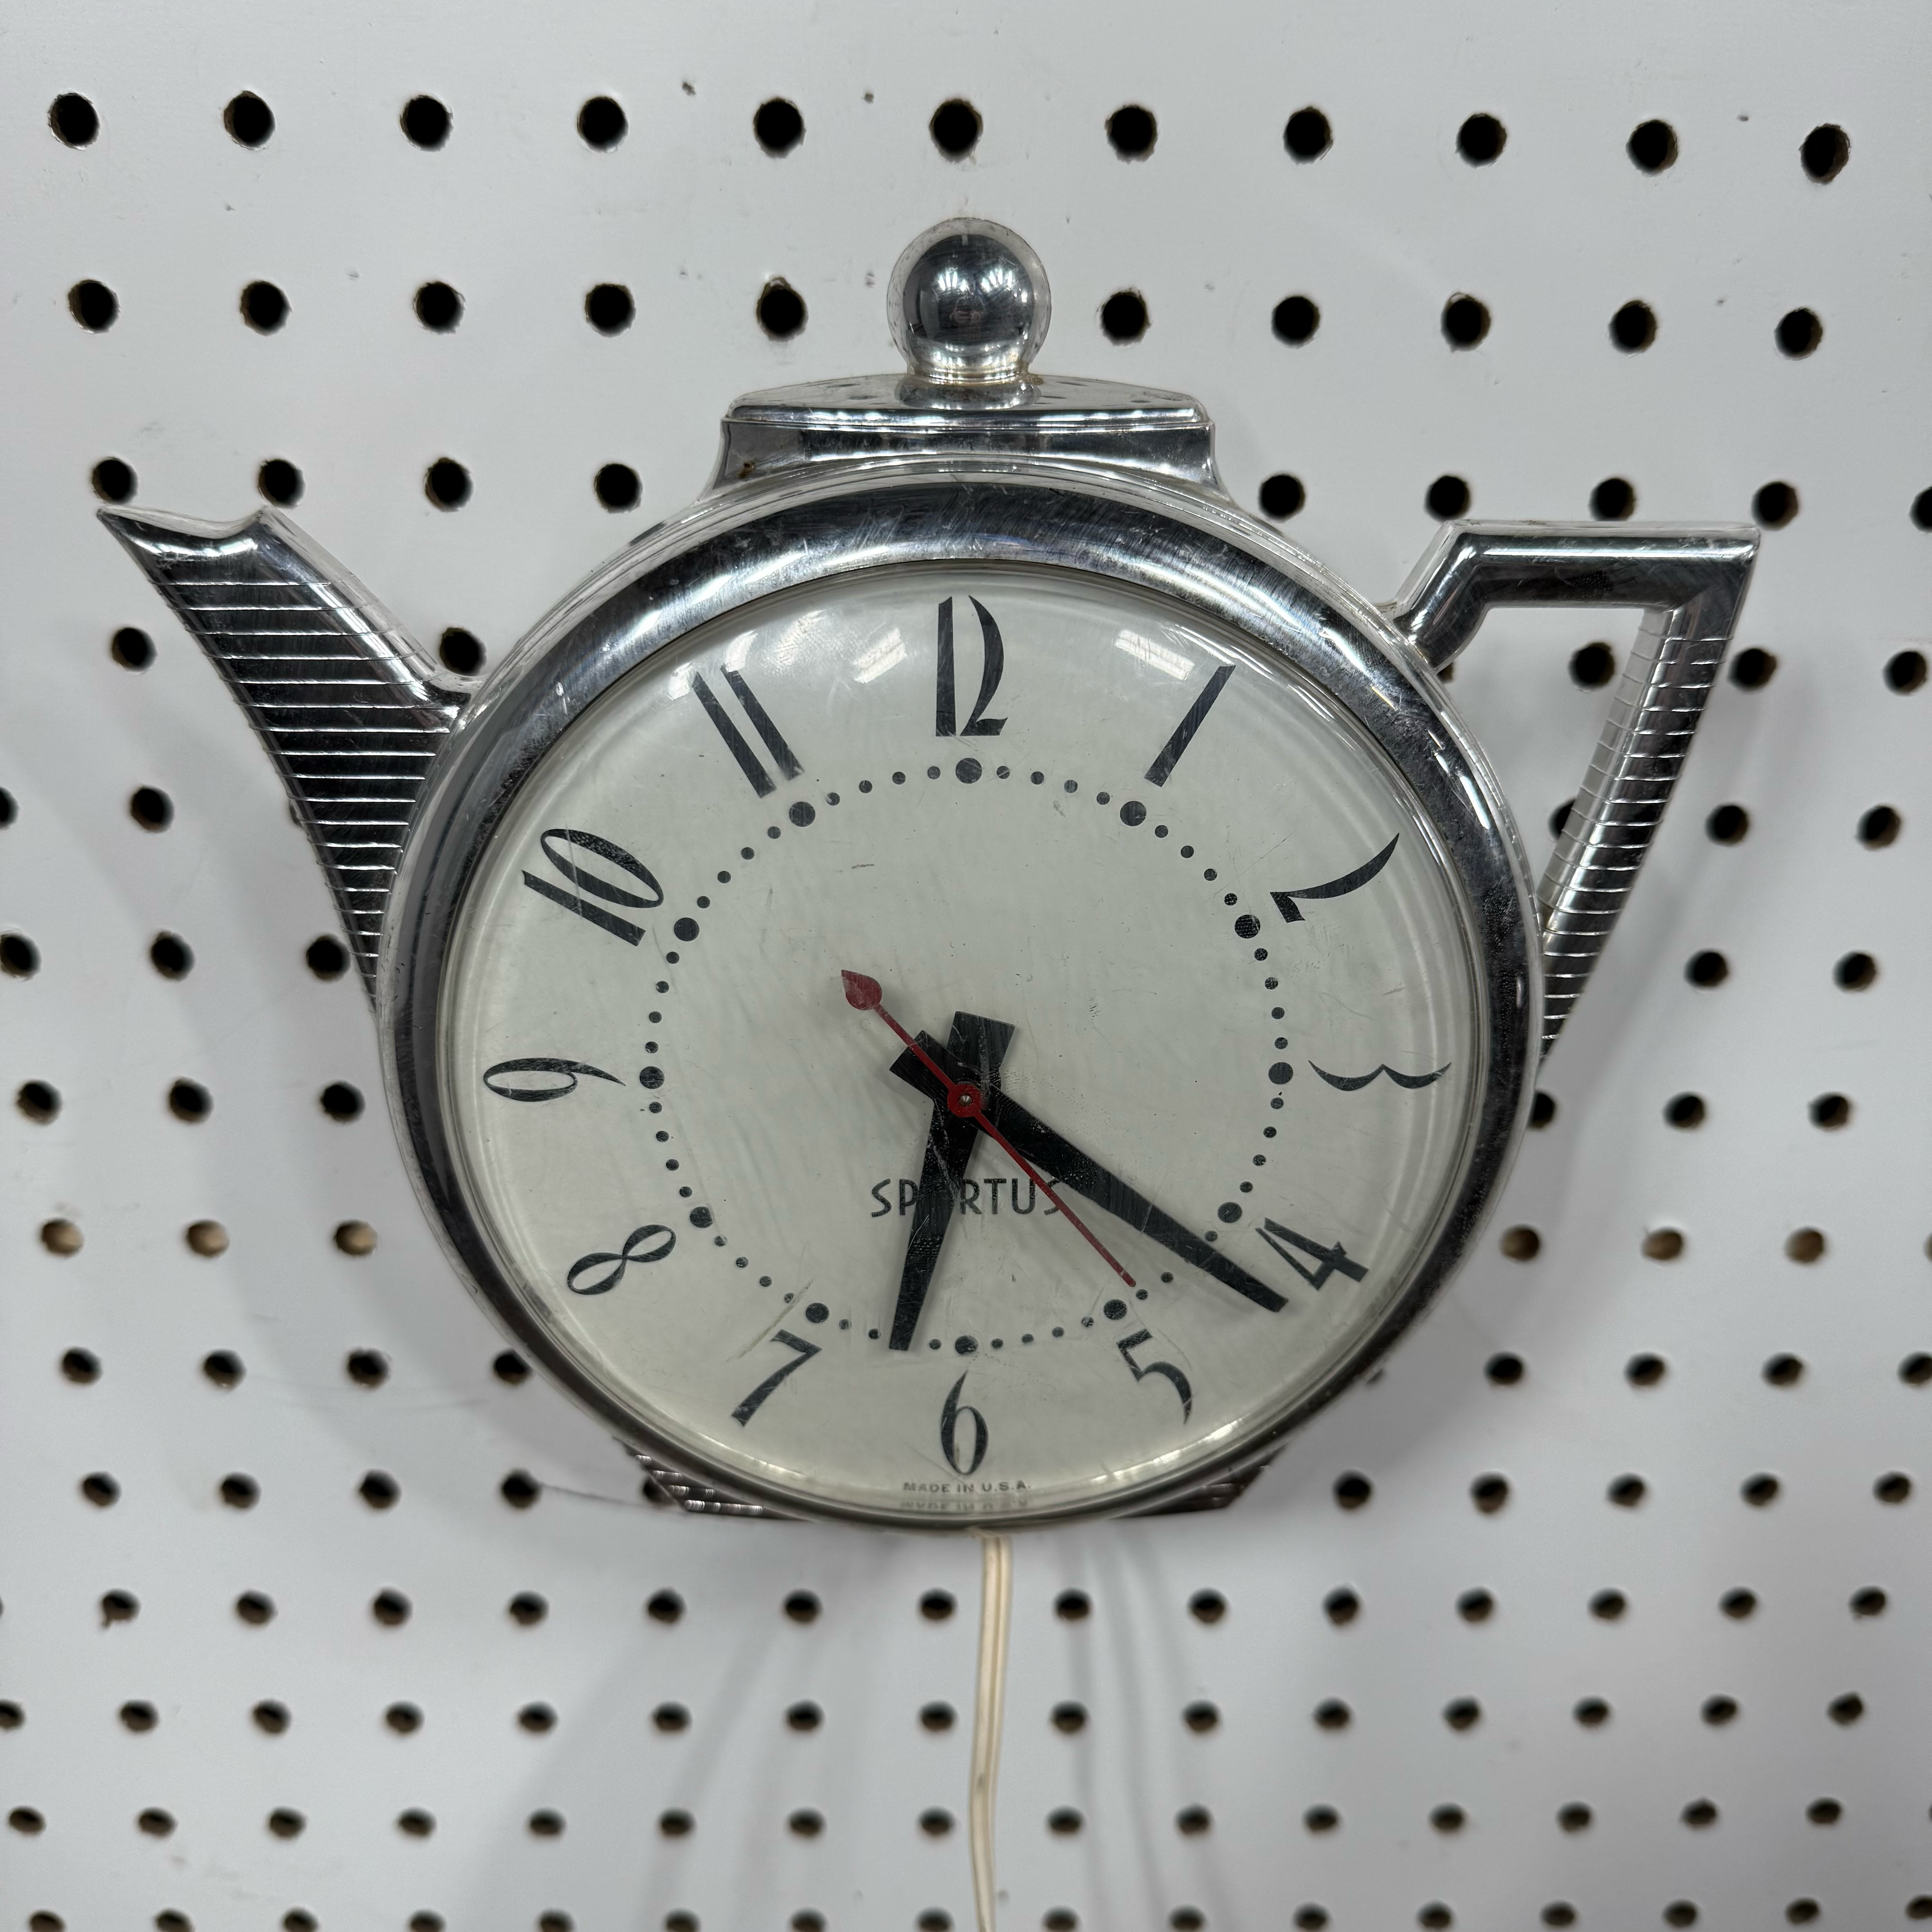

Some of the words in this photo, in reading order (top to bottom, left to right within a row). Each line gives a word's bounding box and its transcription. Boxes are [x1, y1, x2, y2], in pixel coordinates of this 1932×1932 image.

[935, 595, 1008, 737] 12
[693, 667, 805, 799] 11
[1144, 664, 1237, 787] 1
[521, 829, 664, 947] 10
[1270, 832, 1400, 923] 2
[483, 1057, 626, 1102] 9
[1308, 1060, 1452, 1091] 3
[871, 1178, 1061, 1218] SPRTU
[567, 1224, 676, 1295] 8
[1255, 1217, 1369, 1291] 4
[731, 1329, 822, 1427] 7
[1116, 1328, 1192, 1424] 5
[940, 1370, 989, 1476] 6
[903, 1481, 950, 1493] MADE
[957, 1483, 975, 1493] IN
[982, 1480, 1031, 1492] U.S.A.
